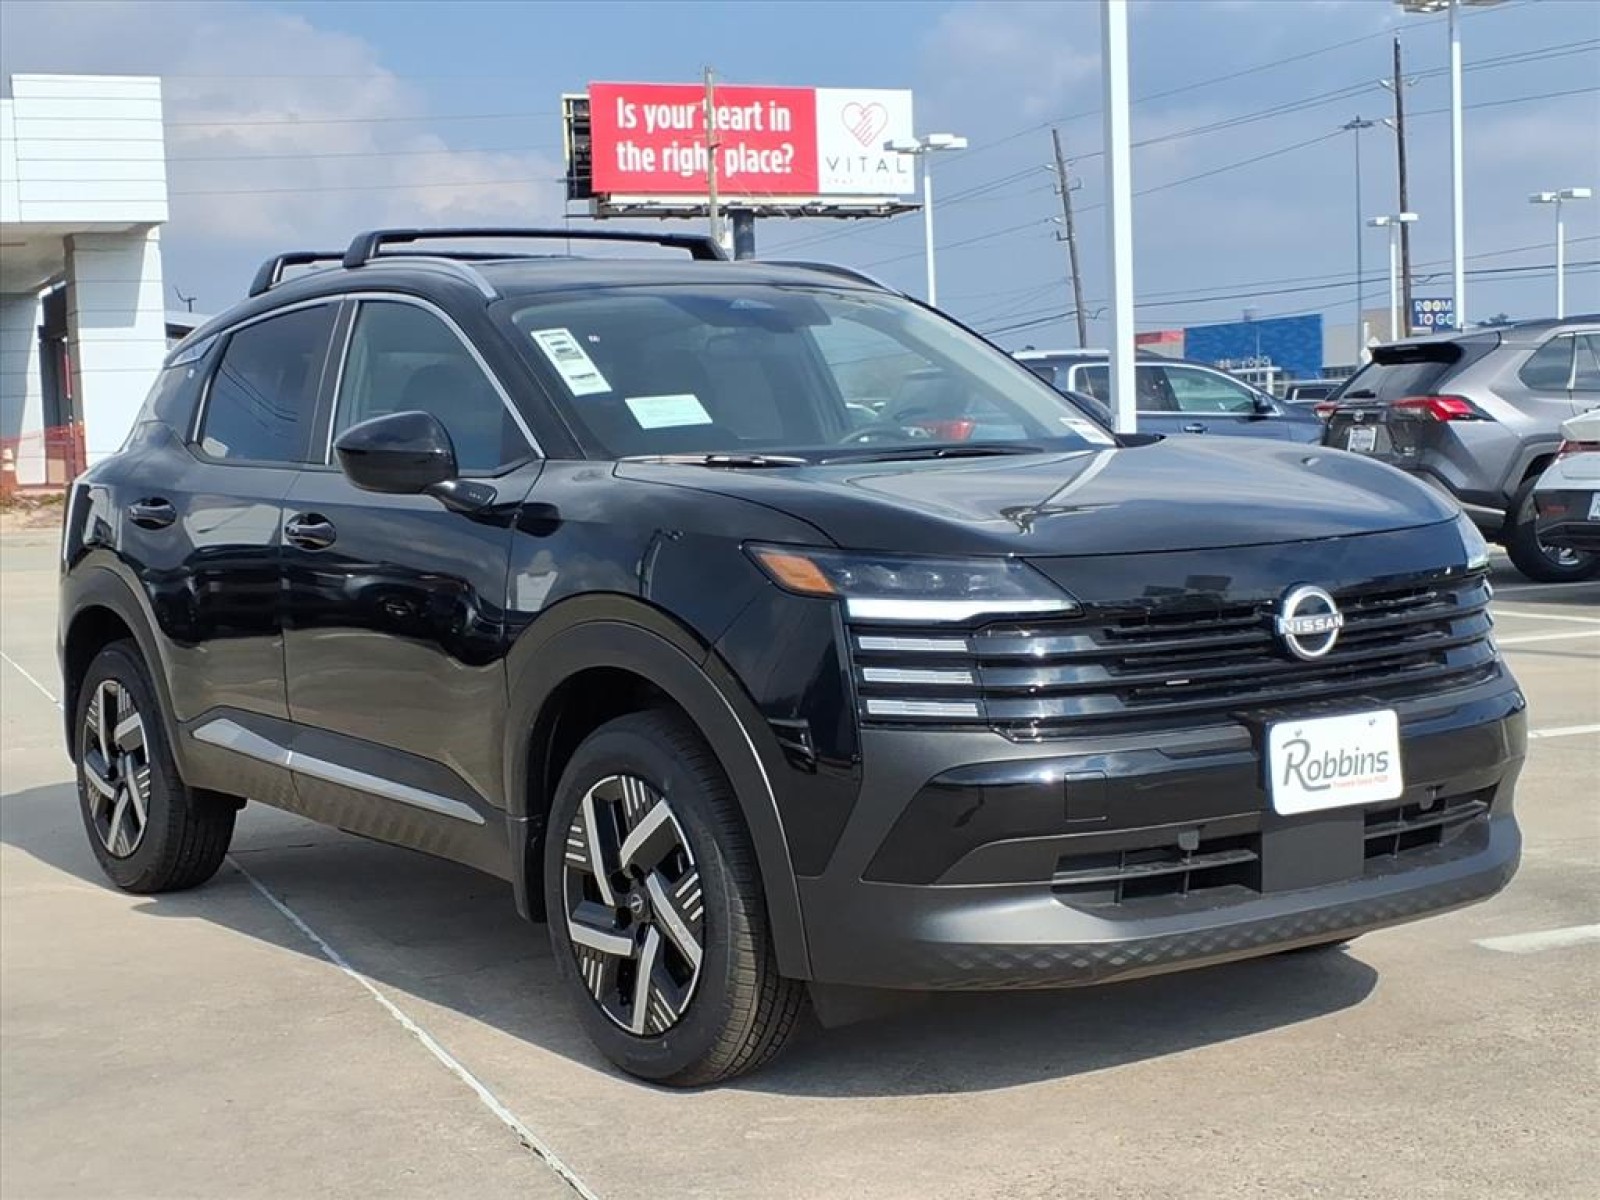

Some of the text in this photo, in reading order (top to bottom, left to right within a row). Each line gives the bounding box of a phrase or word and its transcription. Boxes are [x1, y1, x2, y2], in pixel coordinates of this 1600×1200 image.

[616, 97, 637, 129] Is
[643, 104, 695, 133] your
[769, 100, 791, 131] in
[616, 141, 655, 172] the
[724, 142, 794, 178] place?
[825, 156, 907, 174] VITAL
[1415, 300, 1453, 312] ROOM
[1418, 313, 1434, 326] TO
[1280, 613, 1344, 634] NISSAN
[1281, 738, 1390, 791] Robbins
